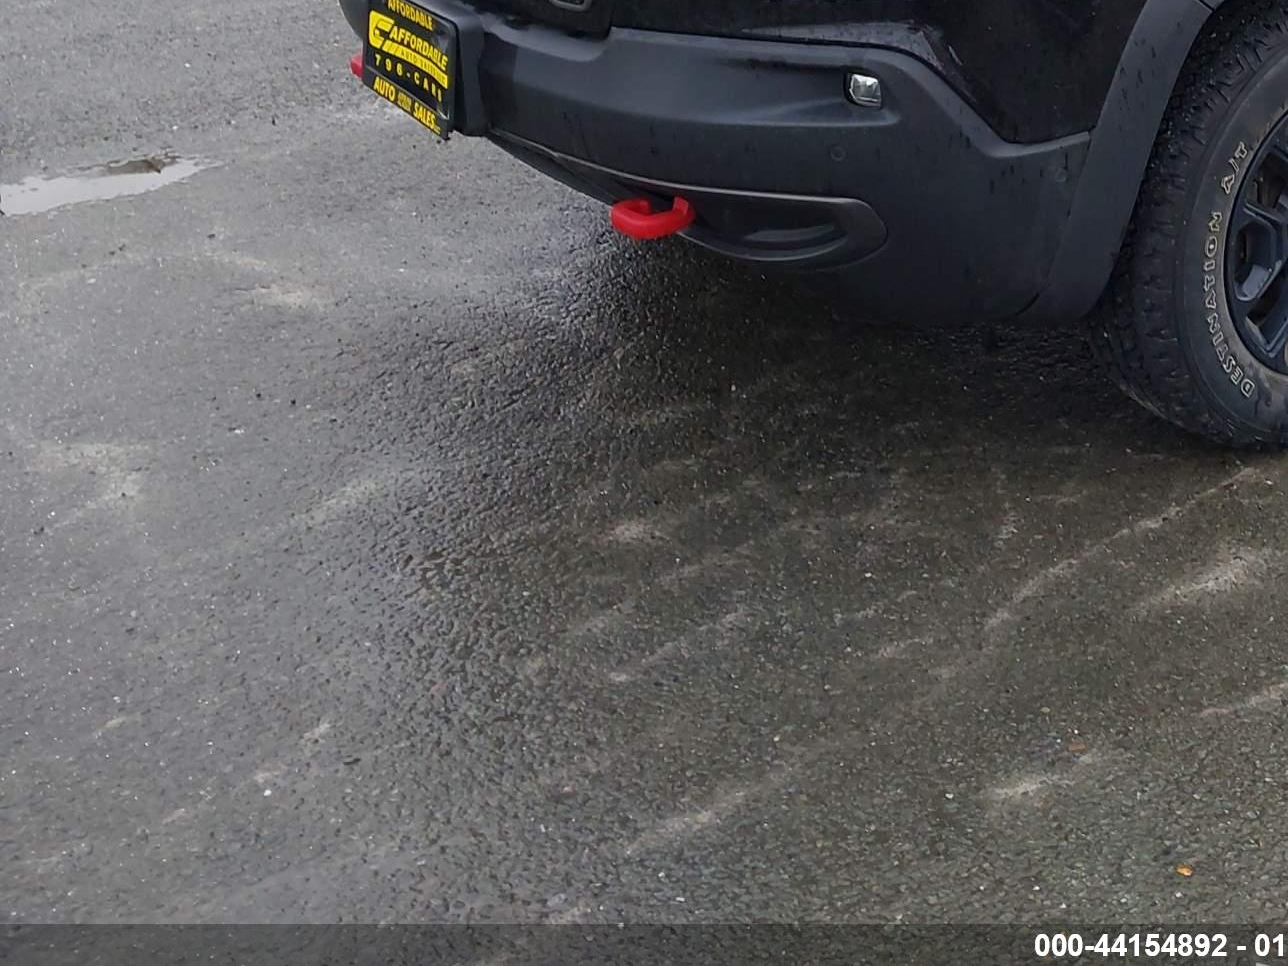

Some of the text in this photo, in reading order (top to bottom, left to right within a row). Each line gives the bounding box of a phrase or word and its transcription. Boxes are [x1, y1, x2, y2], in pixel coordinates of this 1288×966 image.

[389, 26, 448, 71] AFFORDABLE
[373, 75, 396, 102] AUTO
[413, 101, 436, 132] SALES
[1202, 141, 1257, 400] DESTINATION A/T
